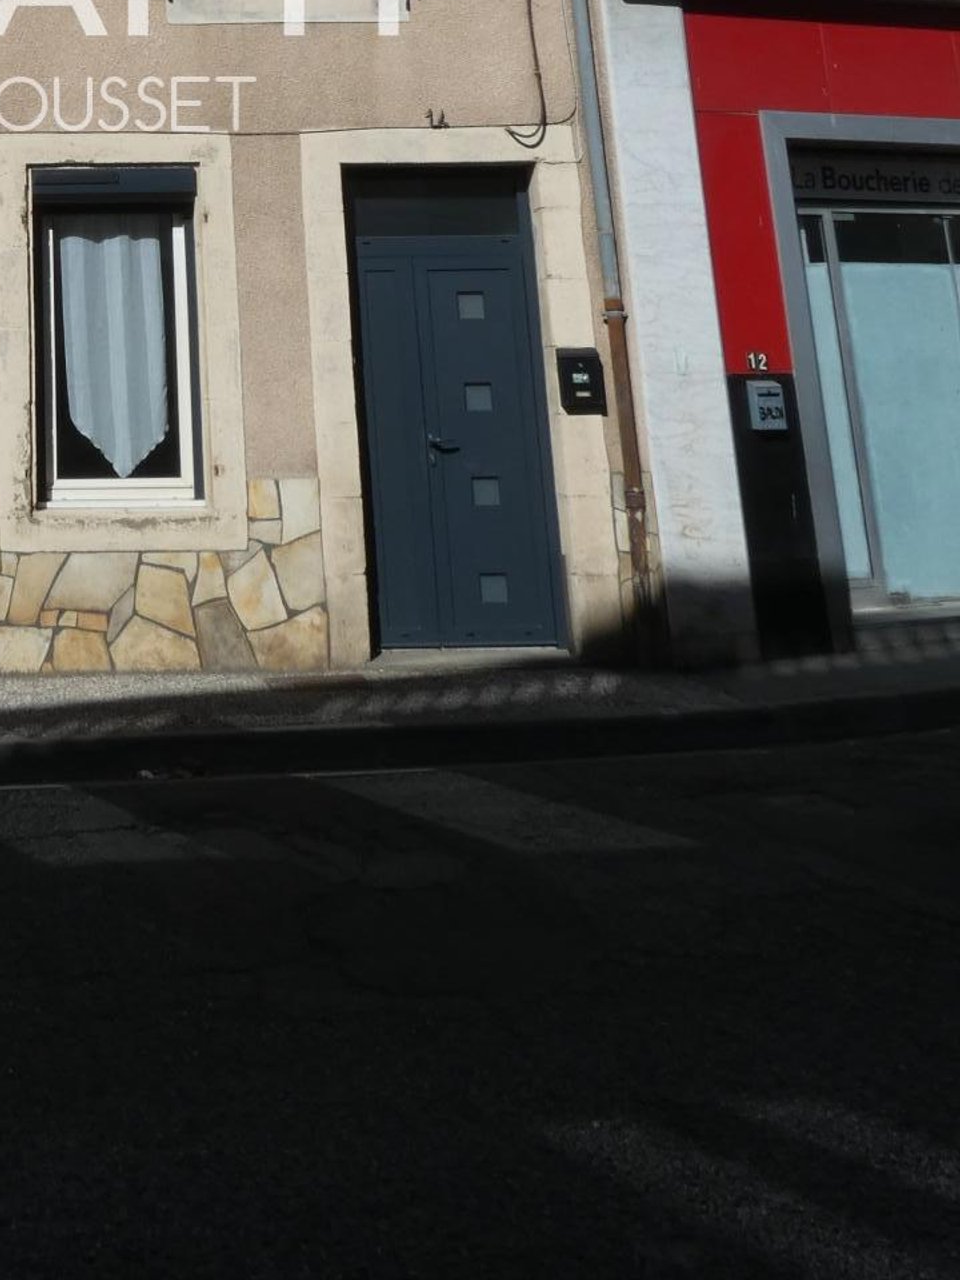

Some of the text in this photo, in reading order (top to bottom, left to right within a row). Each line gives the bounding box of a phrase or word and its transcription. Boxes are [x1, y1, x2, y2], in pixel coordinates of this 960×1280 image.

[791, 166, 815, 190] La
[821, 166, 930, 193] Boucherie
[747, 352, 768, 371] 12
